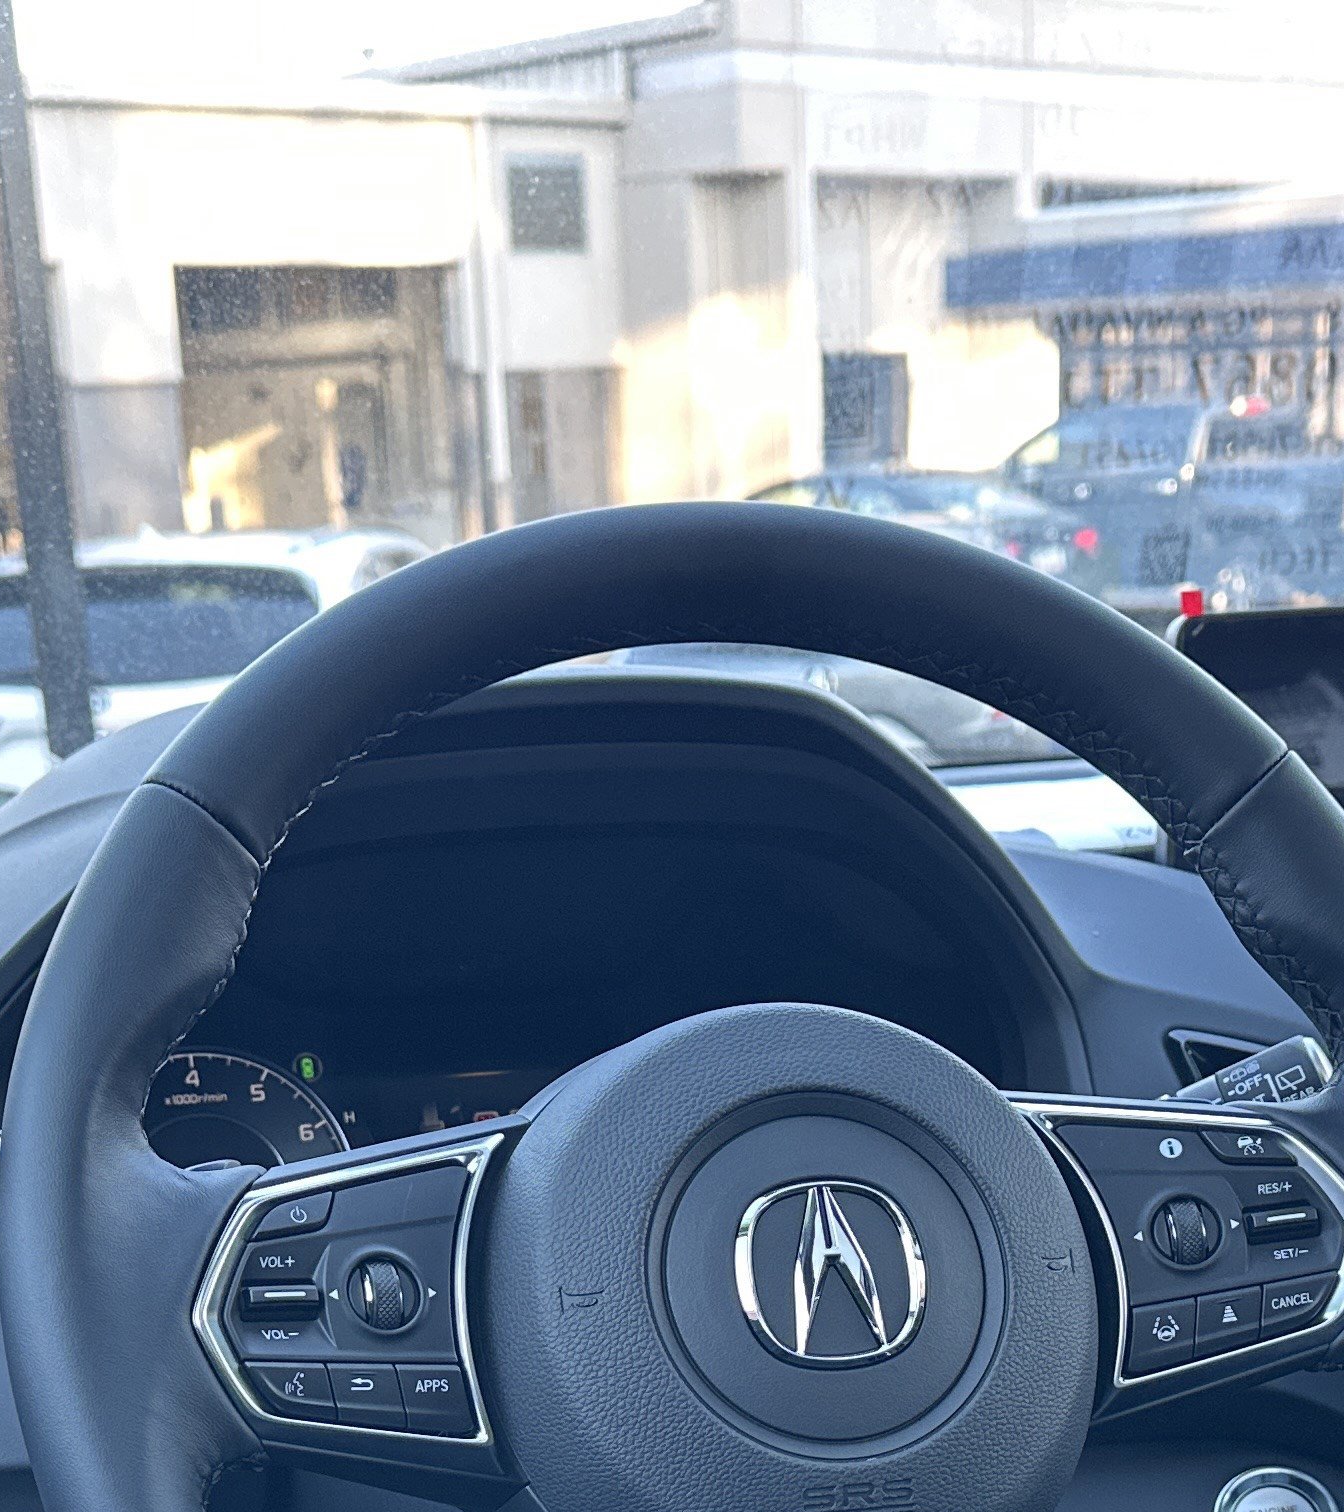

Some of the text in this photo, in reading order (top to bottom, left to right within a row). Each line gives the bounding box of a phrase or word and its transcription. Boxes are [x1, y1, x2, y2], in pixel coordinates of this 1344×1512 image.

[184, 1070, 201, 1088] 4
[1235, 1073, 1264, 1095] OFF
[249, 1084, 266, 1103] 5
[342, 1111, 356, 1124] H
[298, 1124, 315, 1142] 6
[1257, 1180, 1293, 1196] RES/+
[1271, 1292, 1314, 1311] CANCEL
[415, 1378, 450, 1394] APPS
[803, 1478, 915, 1512] SRS
